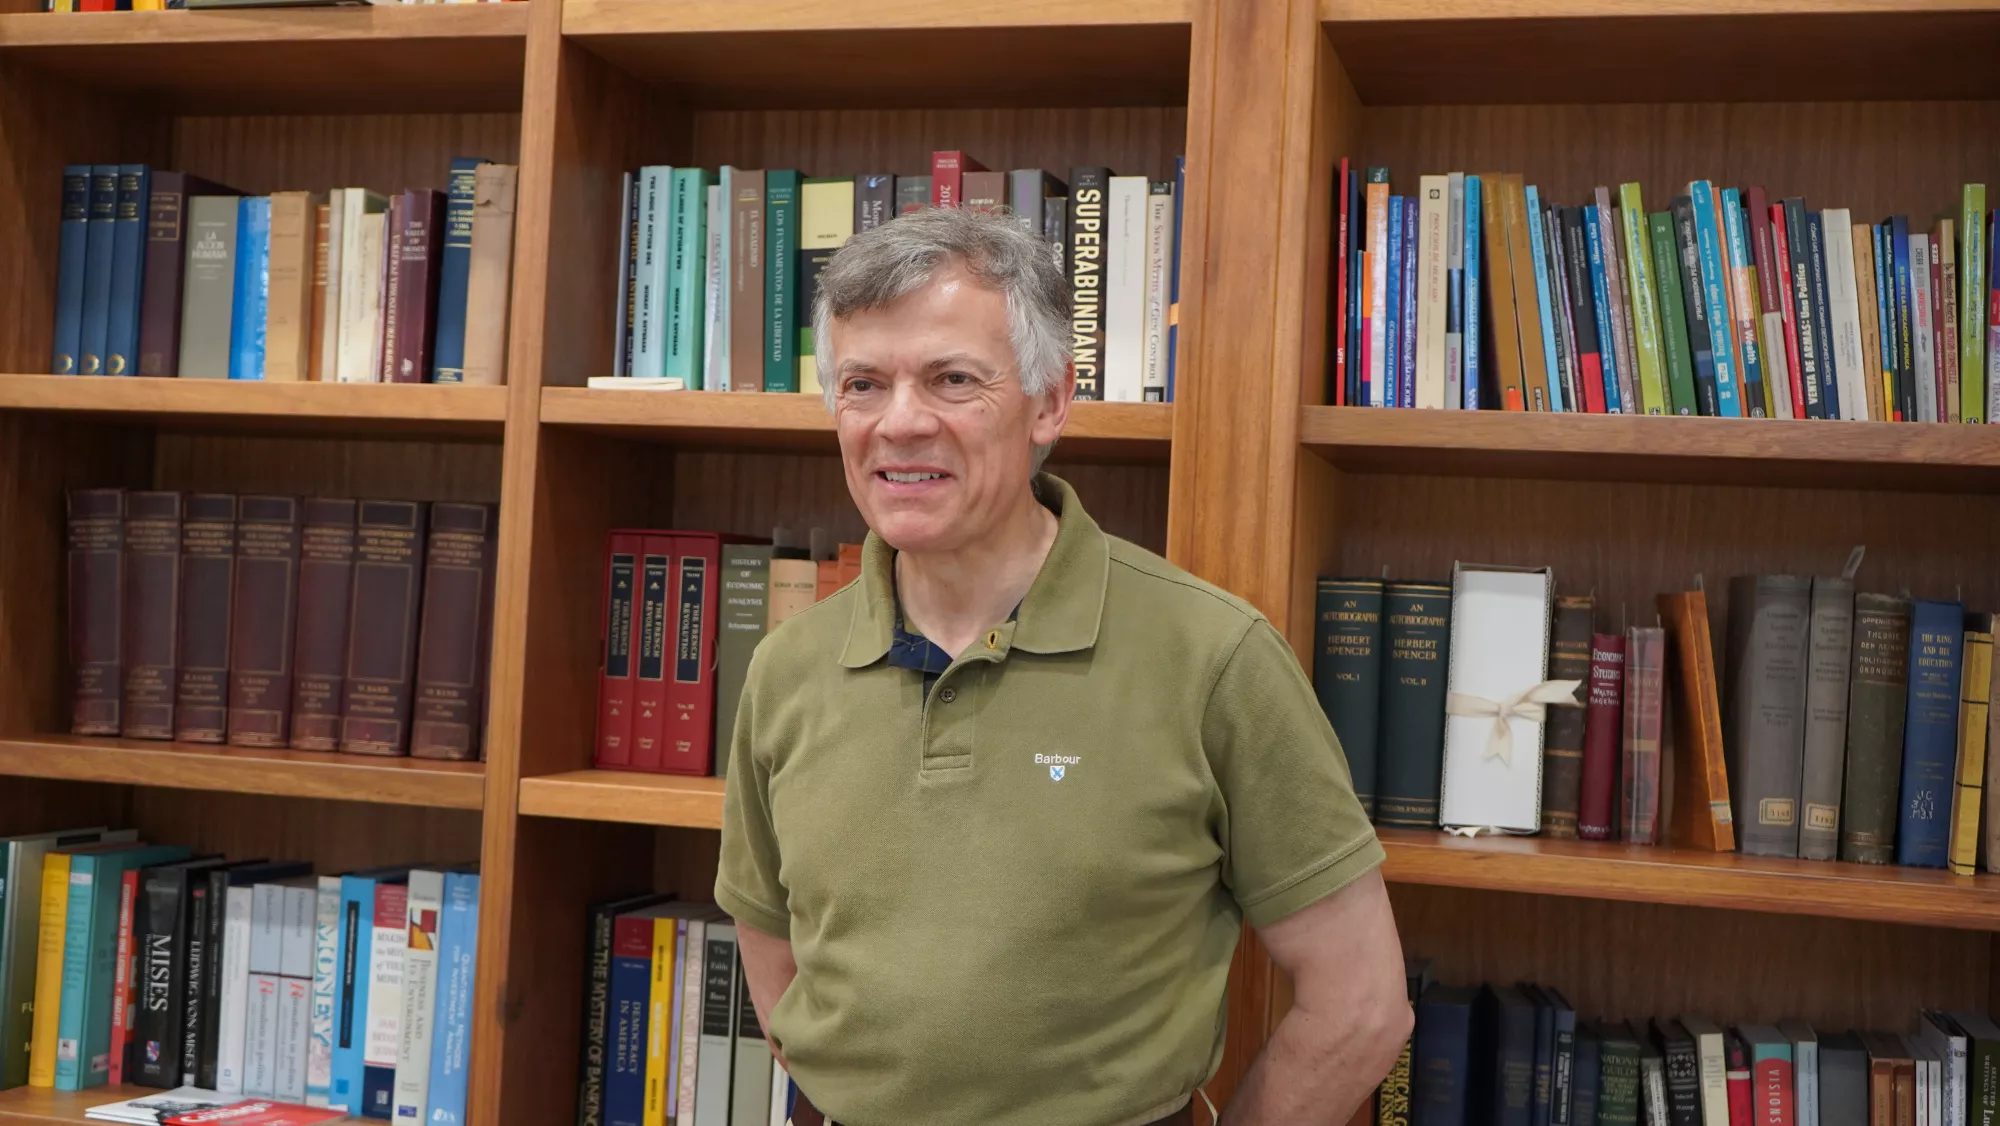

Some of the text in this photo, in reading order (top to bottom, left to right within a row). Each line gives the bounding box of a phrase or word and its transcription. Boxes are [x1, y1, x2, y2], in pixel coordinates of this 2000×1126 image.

[645, 175, 657, 266] THE LOGIC OF ACTION ONE
[676, 177, 687, 270] THE LOGIC OF ACTION TWO
[776, 209, 785, 226] LOS
[630, 221, 640, 260] CAPITAL
[775, 227, 785, 291] FUNDAMENTOS
[774, 293, 784, 307] DE
[1074, 188, 1102, 390] SUPERABUNDANCE
[1900, 286, 1906, 295] DE
[1900, 296, 1907, 304] LA
[628, 280, 637, 328] INTEREST
[773, 307, 783, 319] LA
[1795, 262, 1819, 404] VENTA DE ARMAS: Una Política
[1900, 305, 1910, 342] EDUCACIÓN
[772, 320, 783, 362] LIBERTAD
[1742, 328, 1757, 365] Wealth
[1149, 334, 1160, 380] CONTROL
[1336, 347, 1344, 363] UFM
[1902, 342, 1912, 370] PÚBLICA
[731, 558, 762, 567] HISTORY
[740, 570, 751, 578] OF
[726, 581, 765, 591] ECONOMIC
[727, 597, 763, 606] ANALYSIS
[1344, 600, 1357, 608] AN
[1410, 604, 1424, 612] AN
[609, 598, 621, 655] REVOLUTION
[619, 601, 631, 656] THE FRENCH
[642, 599, 653, 657] REVOLUTION
[651, 602, 662, 658] THE FRENCH
[1322, 611, 1380, 623] AUTOBIOGRAPHY
[1388, 614, 1447, 627] AUTOBIOGRAPHY
[678, 602, 691, 660] REVOLUTION
[688, 603, 700, 661] THE FRENCH
[1328, 635, 1372, 645] HERBERT
[1394, 638, 1438, 649] HERBERT
[1867, 630, 1900, 640] THEORIE
[1920, 633, 1952, 645] THE KING
[1326, 646, 1372, 656] SPENCER
[1391, 650, 1437, 661] SPENCER
[1592, 648, 1624, 663] ECONOMIC
[1918, 656, 1954, 668] EDUCATION
[1922, 646, 1951, 656] AND HIS
[1336, 672, 1356, 681] VOL.
[1593, 665, 1621, 680] STUDIES
[1034, 753, 1081, 765] Barbour
[593, 951, 606, 976] THE
[713, 946, 727, 955] The
[145, 932, 173, 1012] MISES
[309, 921, 338, 1047] MONEY
[717, 978, 729, 986] the
[184, 940, 201, 1068] LUDWIG VON MISES
[413, 958, 431, 1039] BUSINESS AND
[445, 967, 461, 1025] INVESTMENT
[397, 979, 419, 1062] ENVIRONMENT
[450, 953, 471, 1070] QUANTITATIVE METHODS
[589, 982, 604, 1041] MYSTERY
[614, 999, 631, 1073] IN AMERICA
[623, 1000, 643, 1076] DEMOCRACY
[443, 1030, 455, 1076] ANALYSIS
[588, 1044, 601, 1063] OF
[1601, 1055, 1640, 1065] NATIONAL
[1602, 1065, 1638, 1076] GUILDS
[1982, 1054, 1990, 1105] WRITINGS OF
[1767, 1069, 1781, 1124] VISIONS
[1989, 1066, 1997, 1106] SELECTED
